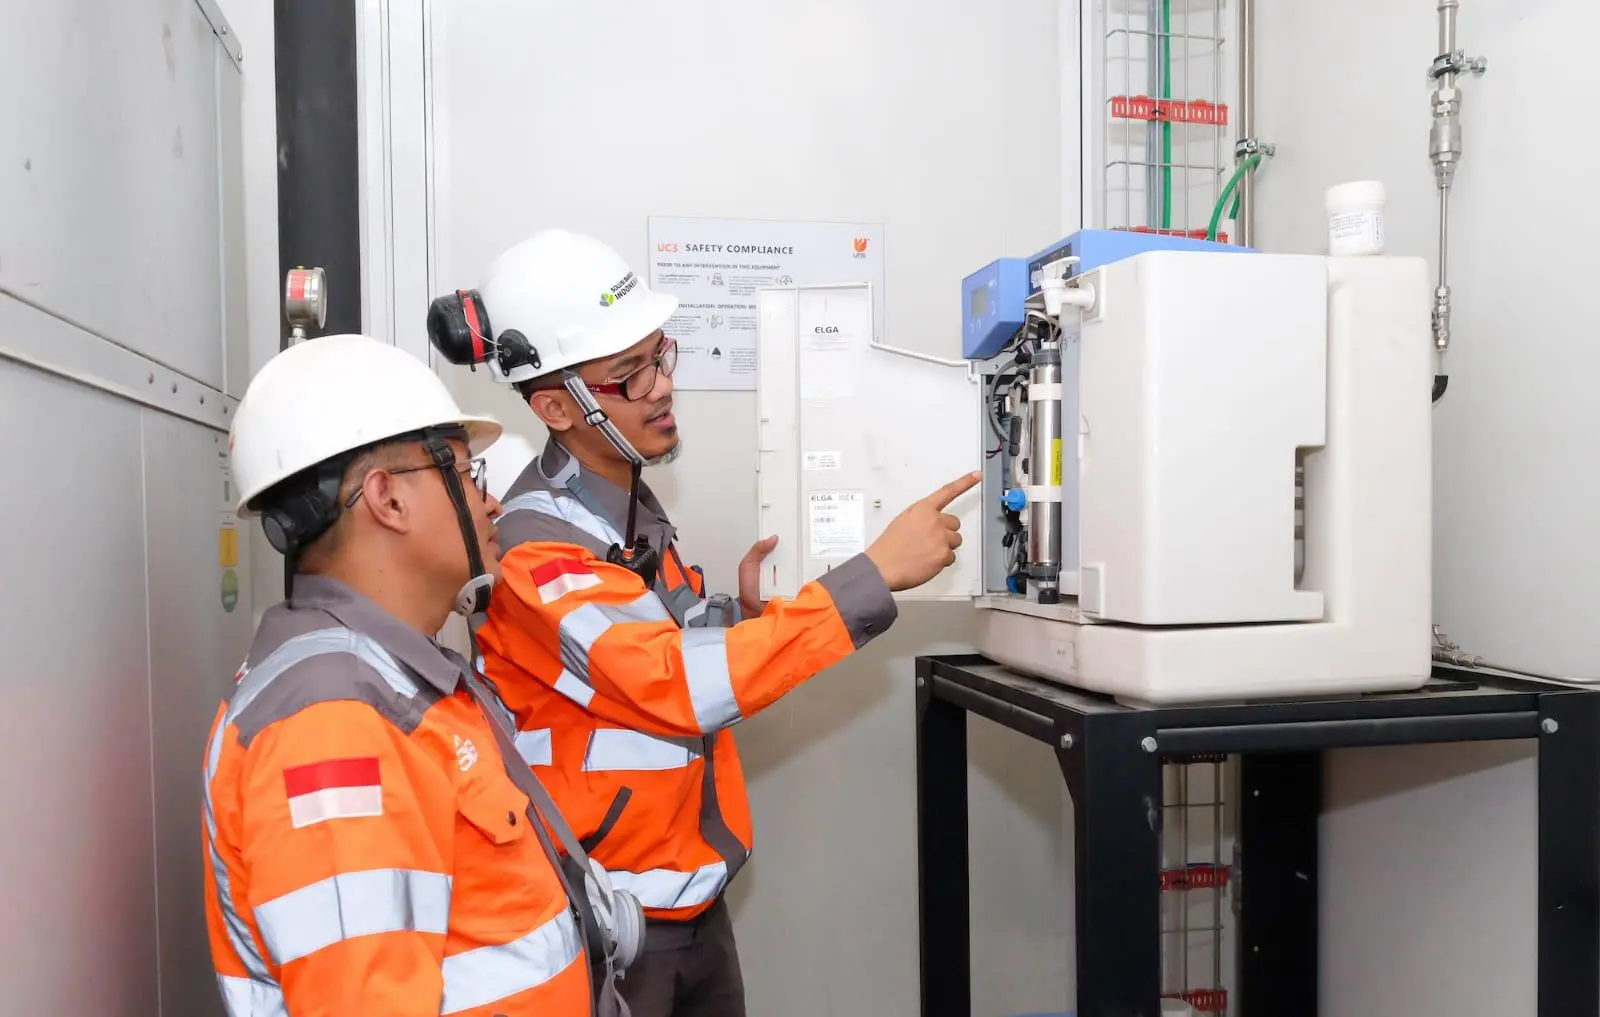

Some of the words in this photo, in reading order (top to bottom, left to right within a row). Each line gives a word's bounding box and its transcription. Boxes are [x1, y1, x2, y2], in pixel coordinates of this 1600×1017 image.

[657, 243, 678, 253] UC3
[685, 243, 723, 253] SAFETY
[726, 245, 793, 255] COMPLIANCE
[814, 326, 839, 334] ELGA
[811, 494, 832, 502] ELGA
